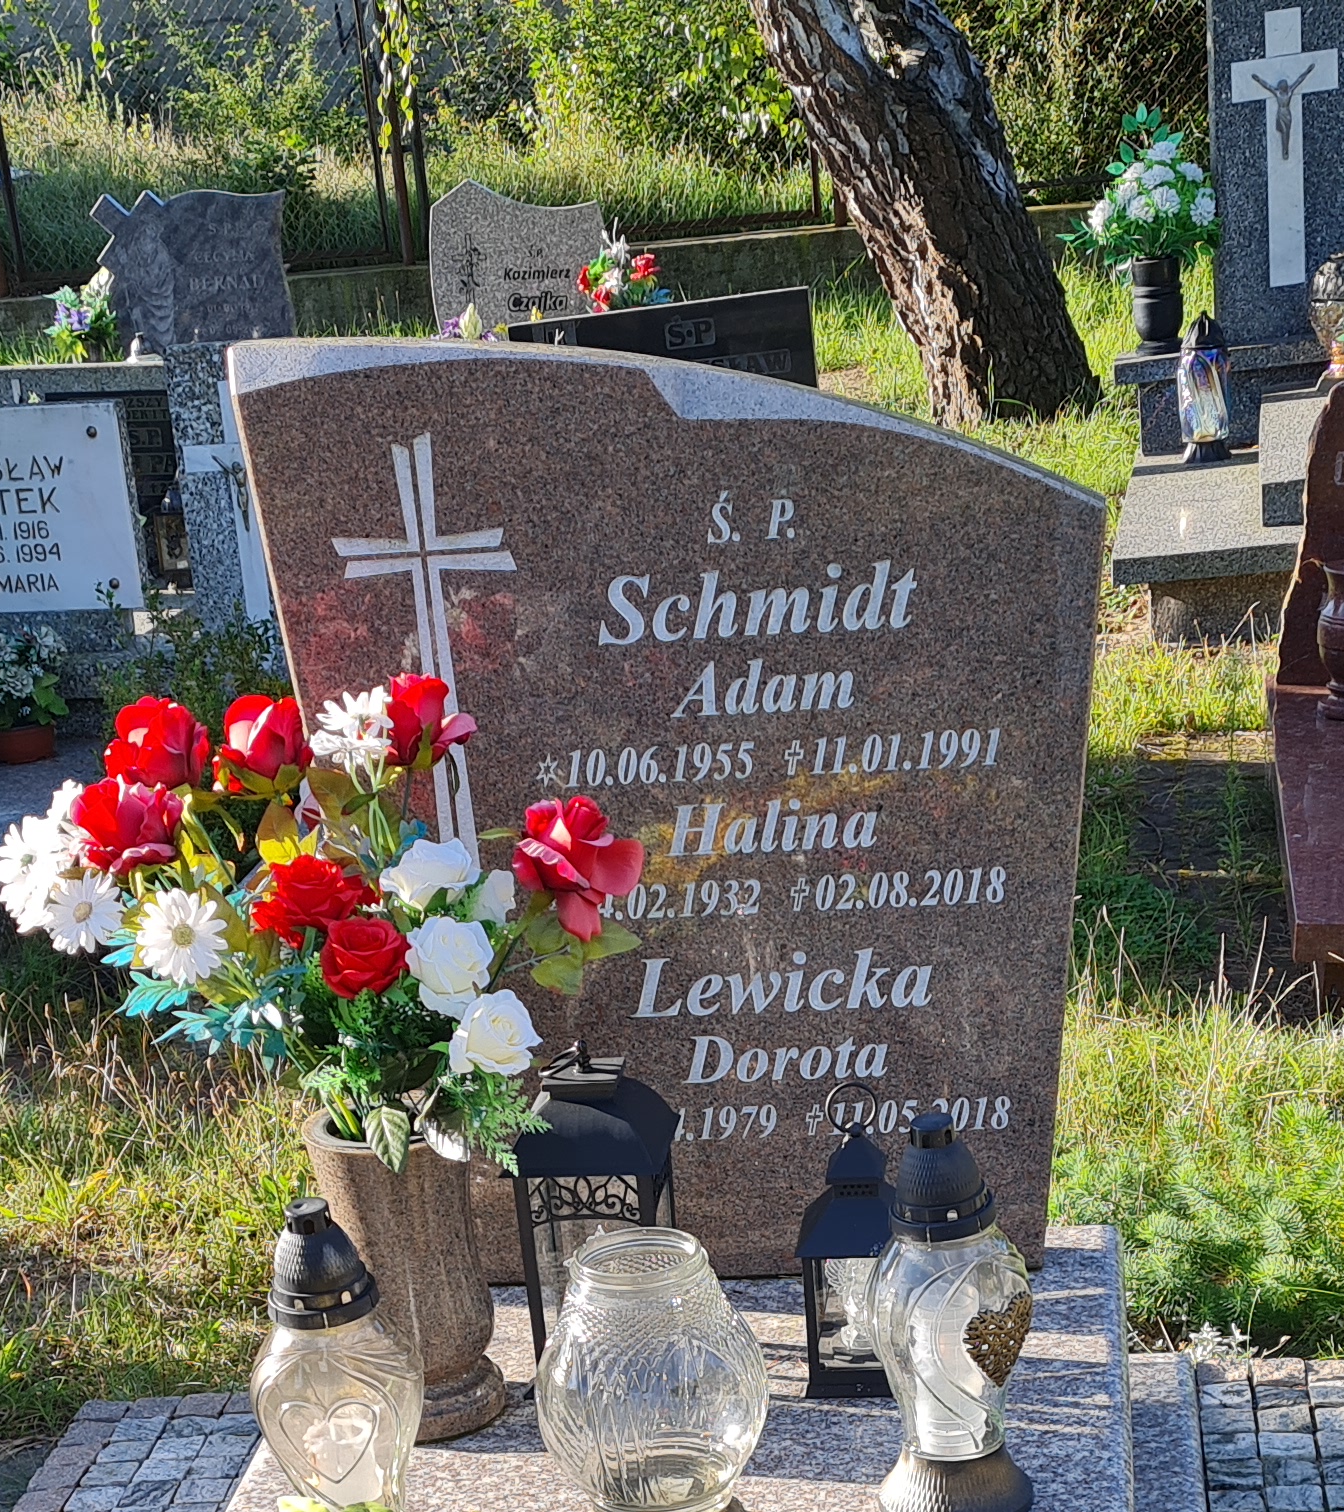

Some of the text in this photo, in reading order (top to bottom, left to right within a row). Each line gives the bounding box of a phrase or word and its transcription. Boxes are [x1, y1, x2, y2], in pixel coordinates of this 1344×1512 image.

[503, 265, 571, 282] Kazimierz
[508, 290, 568, 314] Czajka
[764, 498, 796, 540] P.
[599, 558, 919, 646] Schmidt
[671, 657, 855, 719] Adam
[565, 726, 1002, 788] 10.06.1955 11.01.1991
[665, 798, 878, 857] Halina
[598, 865, 1007, 921] 4.02.1932 02.08.2018
[627, 947, 934, 1020] Lewicka
[682, 1034, 889, 1085] Dorota
